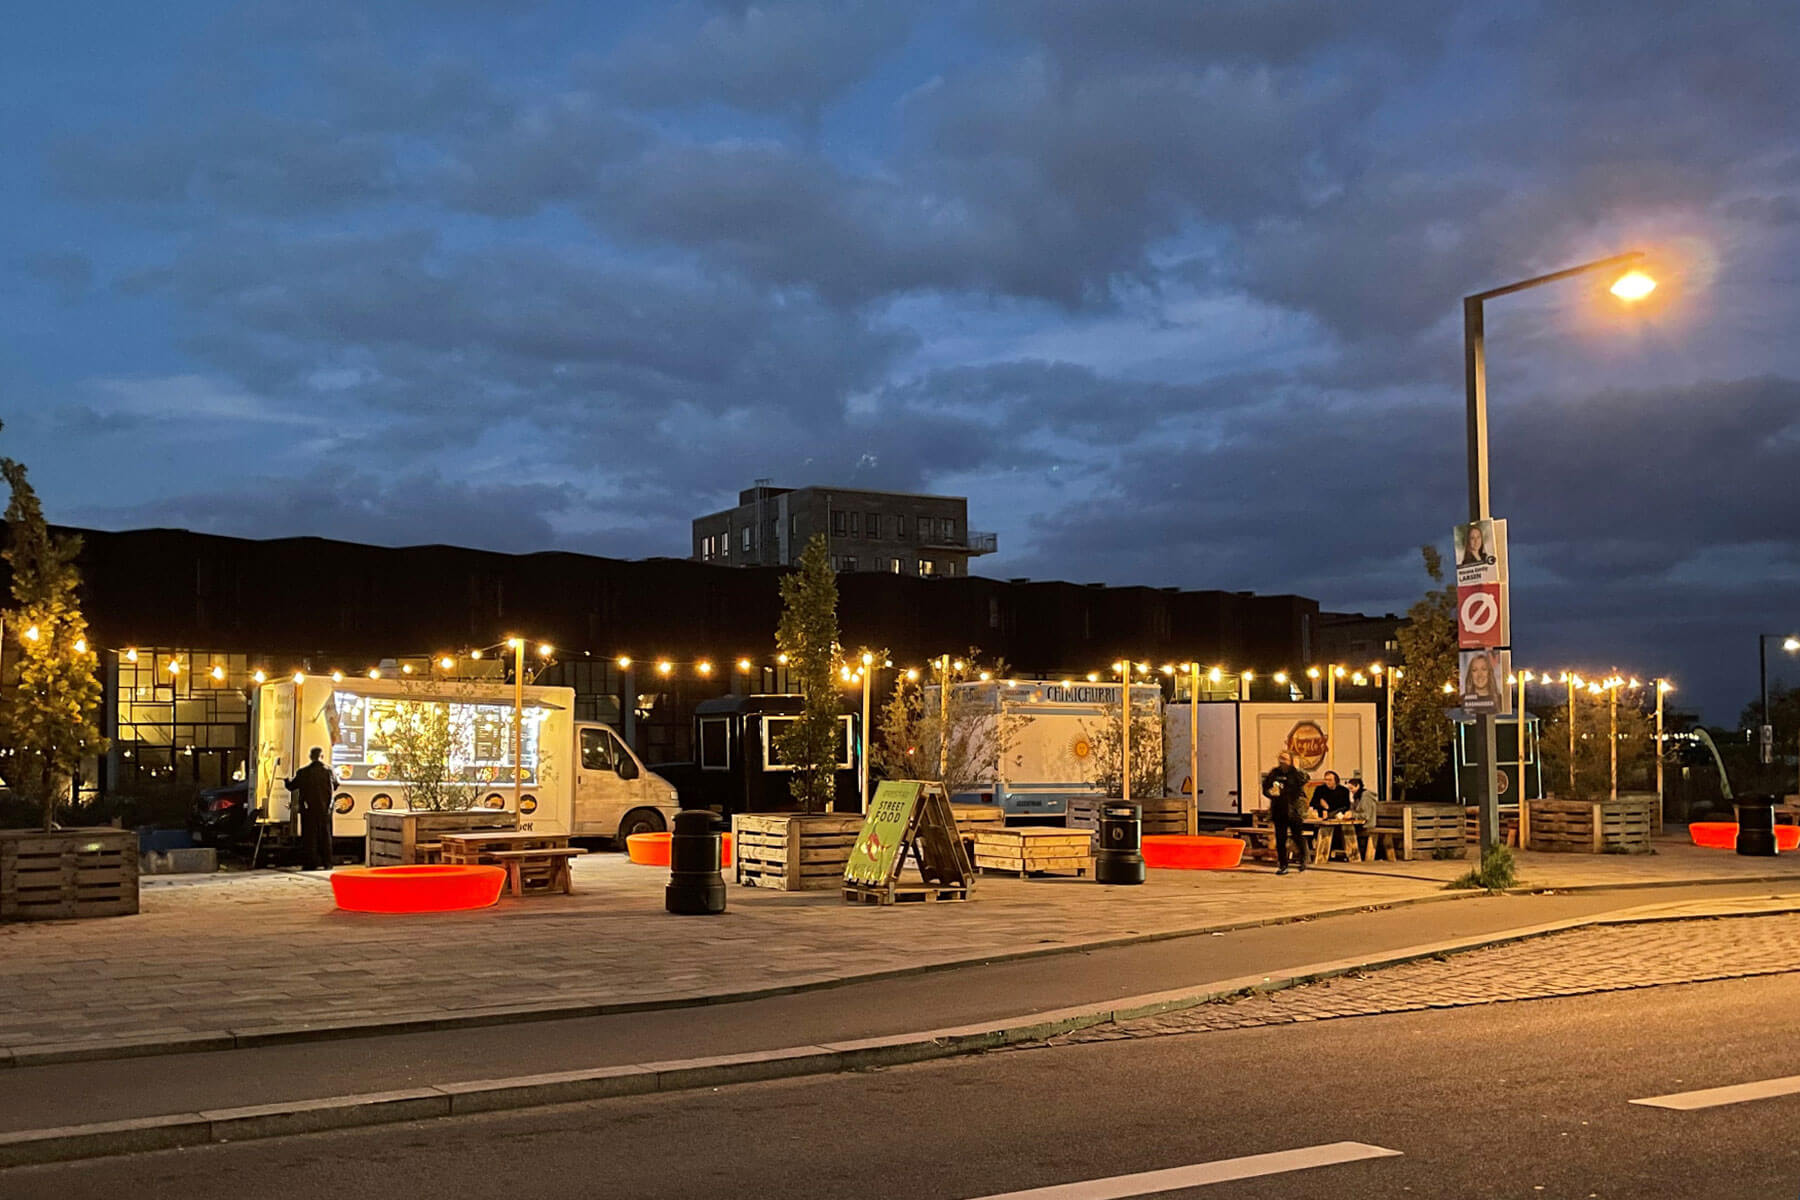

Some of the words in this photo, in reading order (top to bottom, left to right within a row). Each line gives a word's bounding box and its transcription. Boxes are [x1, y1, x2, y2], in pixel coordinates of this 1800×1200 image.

[1459, 573, 1482, 582] LARSEN
[1047, 686, 1115, 702] CHIMICHURRI
[878, 800, 905, 812] STREET
[875, 811, 901, 823] FOOD
